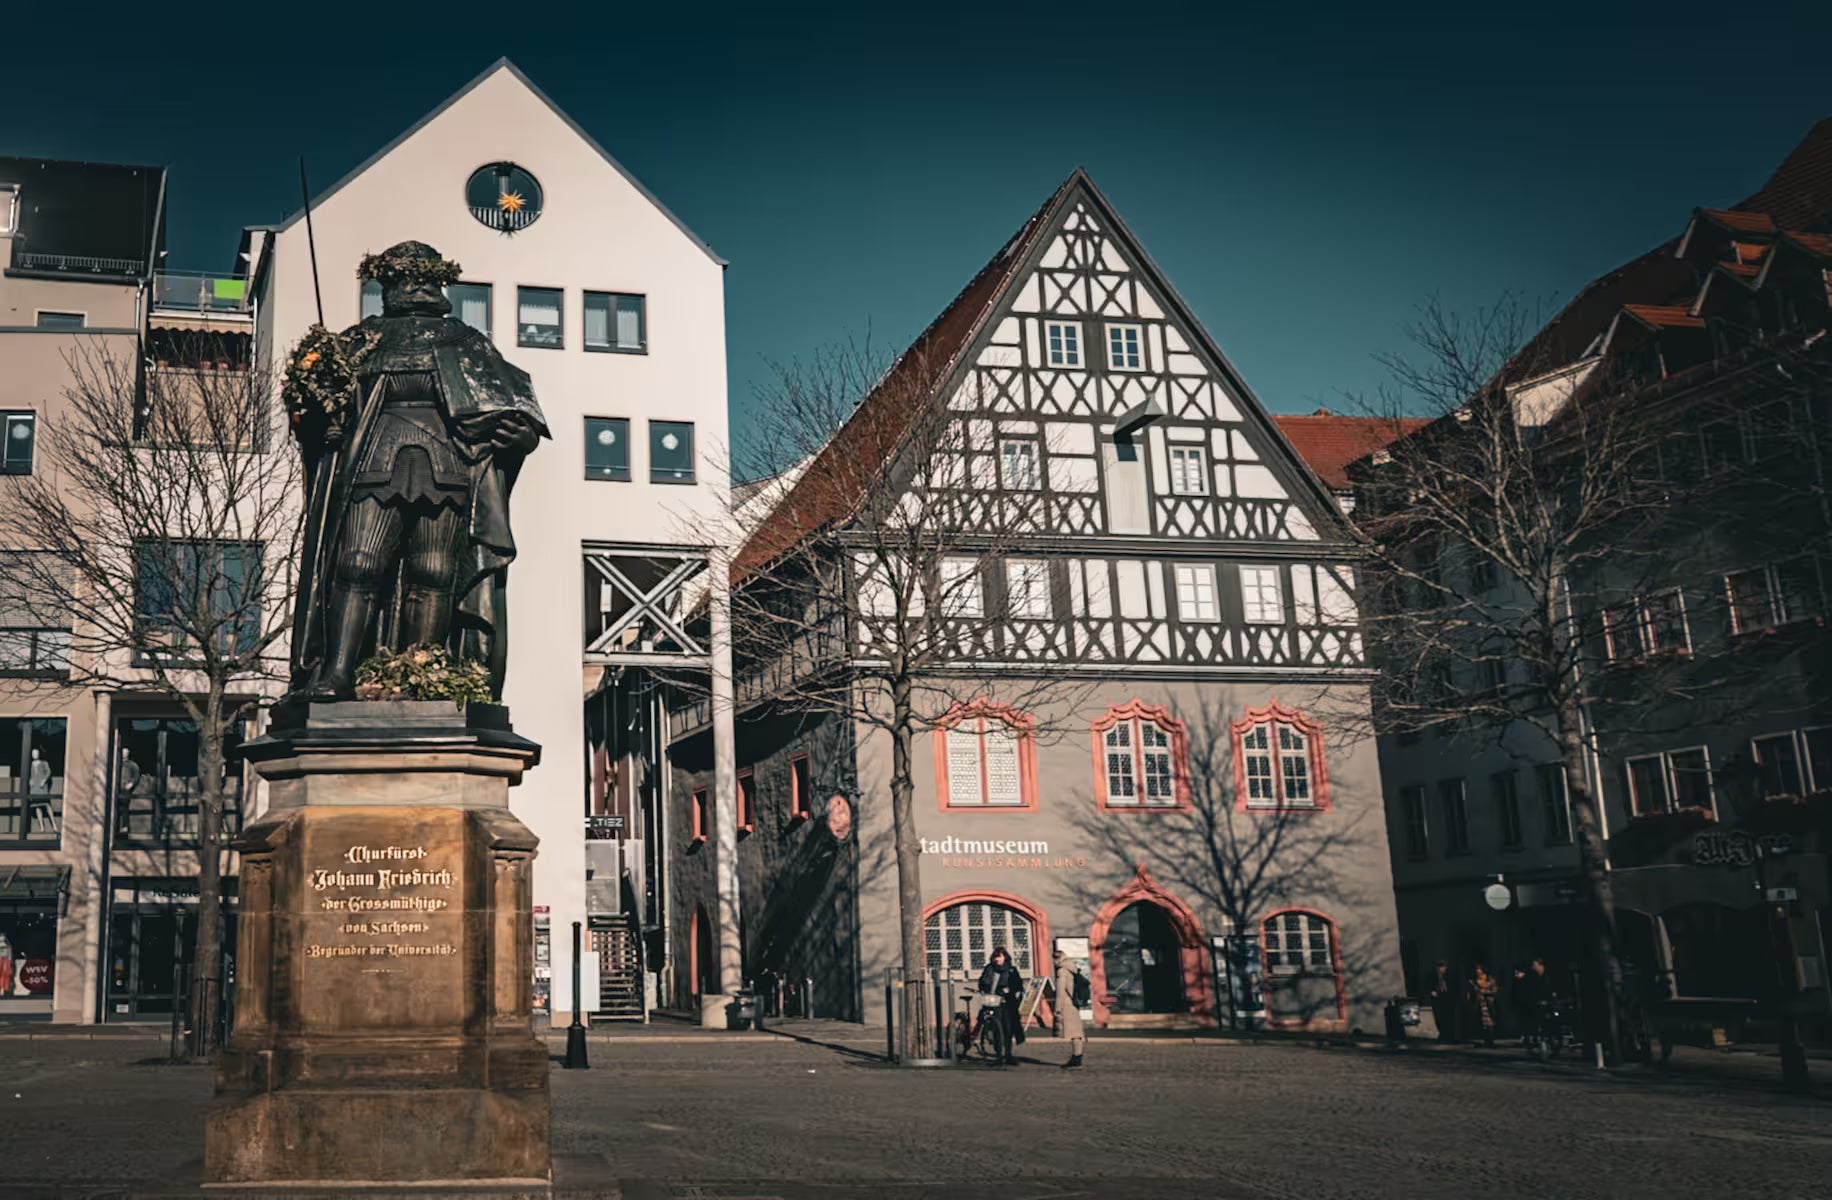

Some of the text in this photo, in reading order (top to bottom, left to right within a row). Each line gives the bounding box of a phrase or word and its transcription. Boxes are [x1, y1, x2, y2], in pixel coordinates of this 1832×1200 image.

[920, 835, 1049, 854] tadtmuseum
[313, 868, 452, 891] Johann Friedrich
[325, 898, 346, 910] der
[345, 921, 422, 936] von Sachsen
[311, 943, 453, 958] Begründer der Universität
